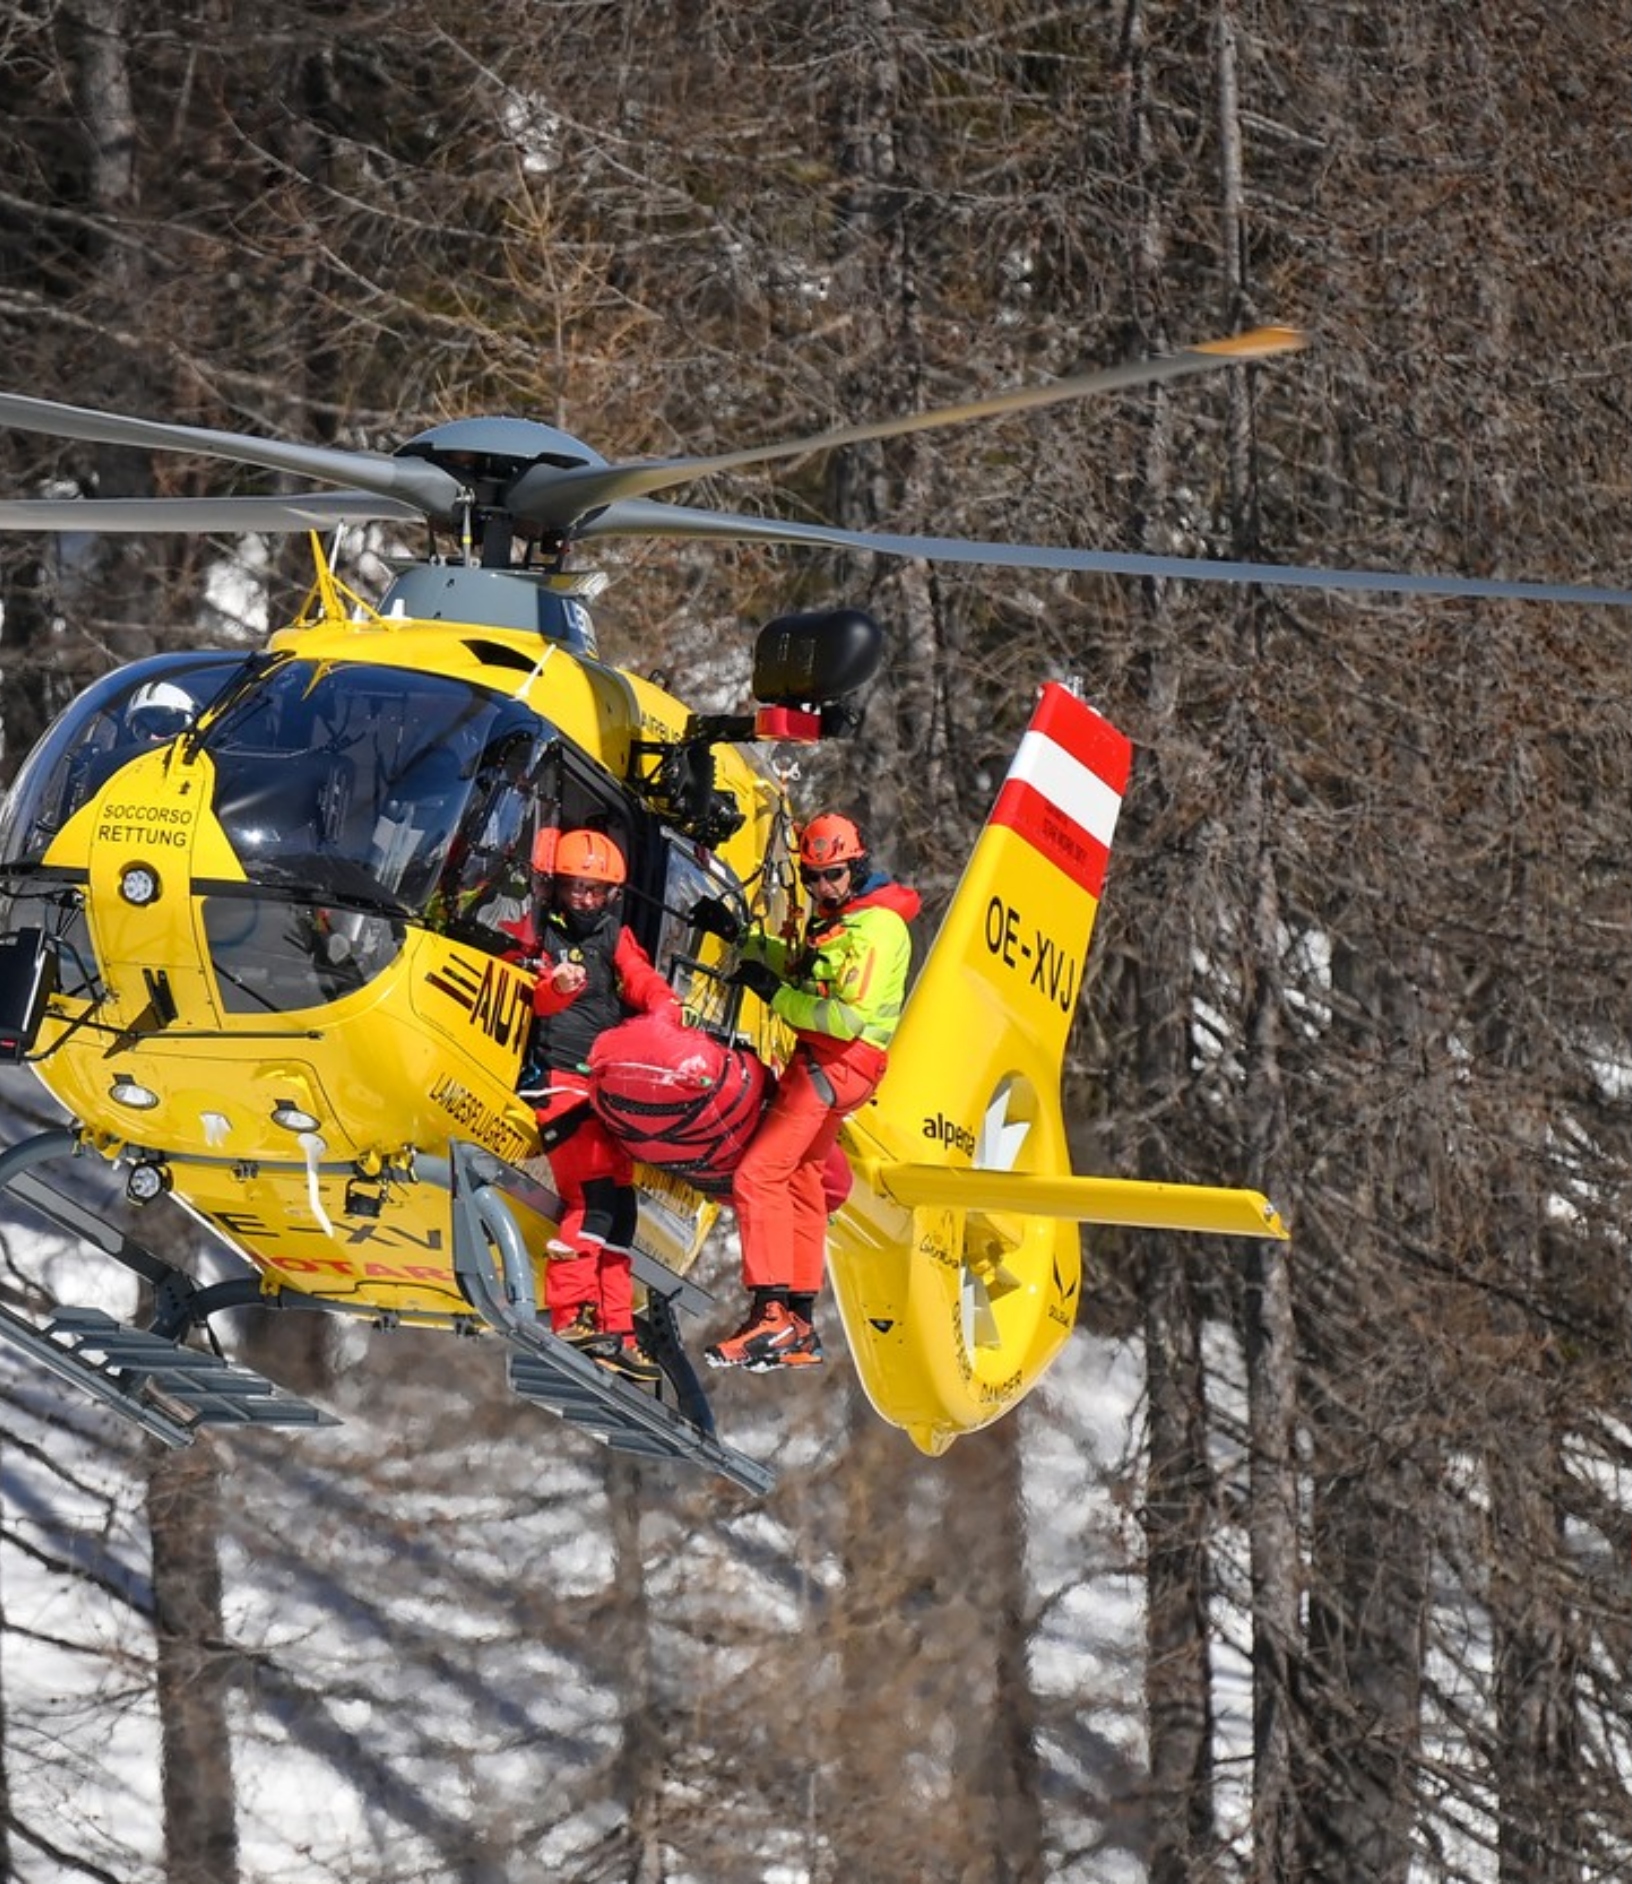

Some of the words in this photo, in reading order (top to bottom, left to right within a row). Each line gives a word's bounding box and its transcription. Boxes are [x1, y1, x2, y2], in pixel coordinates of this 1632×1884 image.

[103, 804, 193, 826] SOCCORSO
[98, 824, 188, 848] RETTUNG
[985, 895, 1075, 1014] OE-XVJ
[252, 1252, 456, 1282] OTAR
